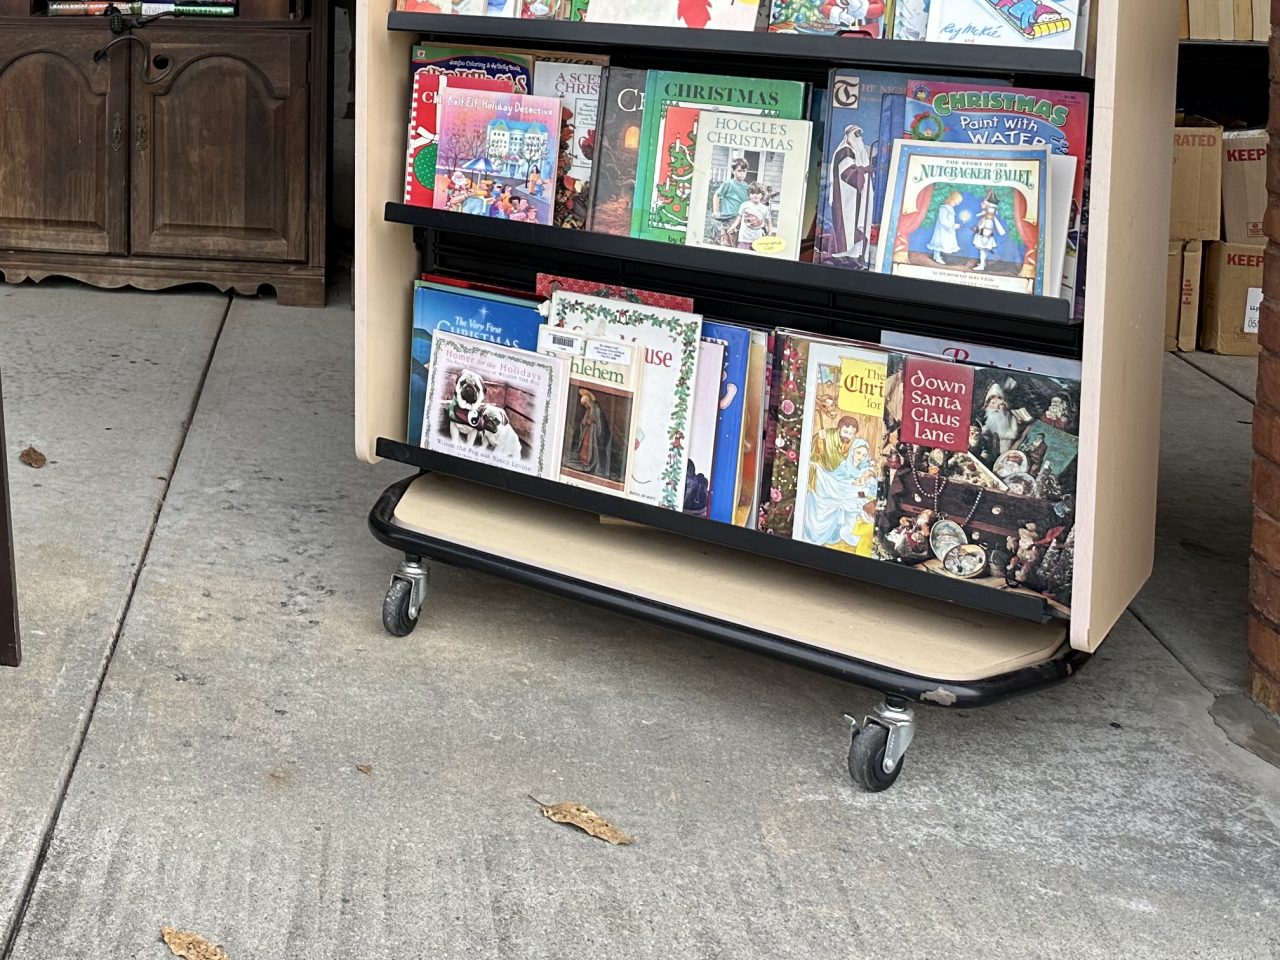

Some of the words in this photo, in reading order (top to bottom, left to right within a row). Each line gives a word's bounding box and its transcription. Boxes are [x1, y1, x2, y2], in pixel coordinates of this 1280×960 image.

[556, 72, 565, 82] A
[665, 83, 779, 106] CHRISTMAS
[482, 98, 513, 115] Holiday
[514, 102, 553, 116] Detective
[934, 92, 1068, 127] CHRISTMAS
[716, 117, 787, 136] HOGGLE'S
[961, 116, 998, 130] Paint
[1004, 116, 1038, 132] With
[707, 132, 794, 151] CHRISTMAS
[968, 131, 1046, 145] WATER
[1174, 134, 1217, 147] RATED
[1227, 148, 1266, 162] KEEP
[913, 164, 992, 182] NUTCRACKER
[994, 168, 1034, 189] BALLET
[1227, 253, 1264, 267] KEEP
[454, 317, 467, 327] The
[469, 319, 484, 331] Very
[486, 323, 502, 334] First
[500, 363, 541, 380] Holidays
[865, 368, 885, 381] The
[911, 370, 966, 394] down
[912, 391, 962, 411] Santa
[912, 408, 960, 427] Claus
[915, 422, 954, 444] Lane
